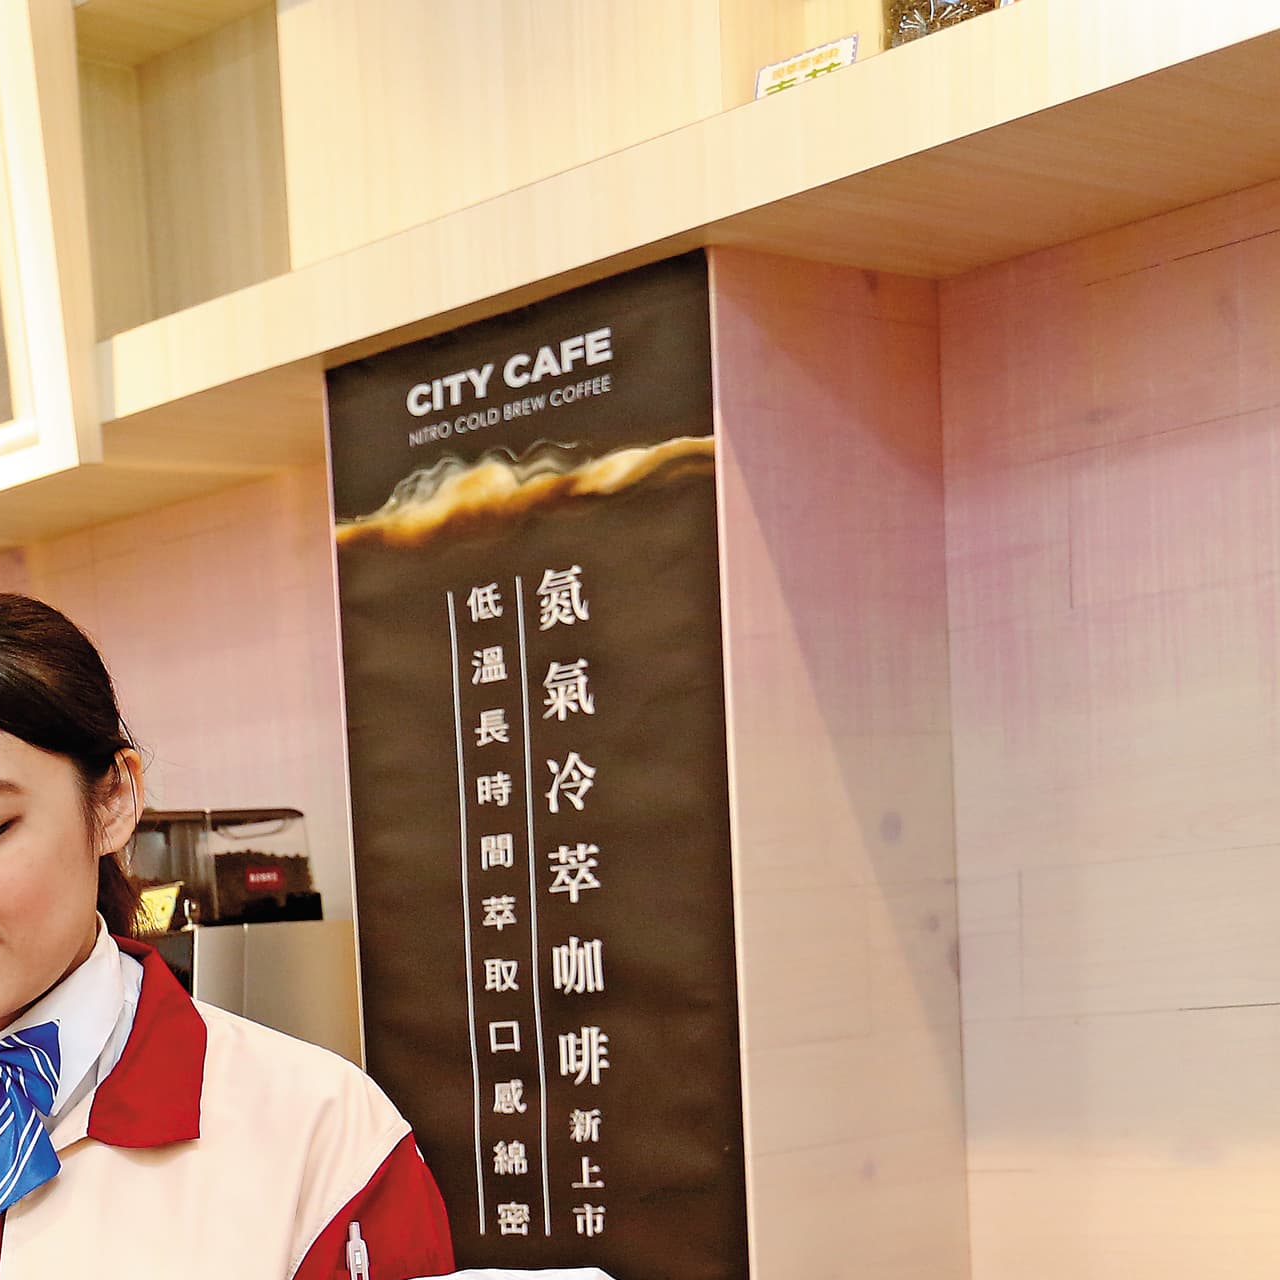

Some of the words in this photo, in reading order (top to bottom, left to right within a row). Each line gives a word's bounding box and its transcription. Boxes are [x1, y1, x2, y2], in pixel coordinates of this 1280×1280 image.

[405, 364, 494, 418] CITY
[503, 326, 614, 390] CAFE
[409, 419, 453, 447] NITRO
[454, 406, 500, 434] COLD
[503, 396, 547, 422] BREW
[549, 375, 613, 408] COFFEE
